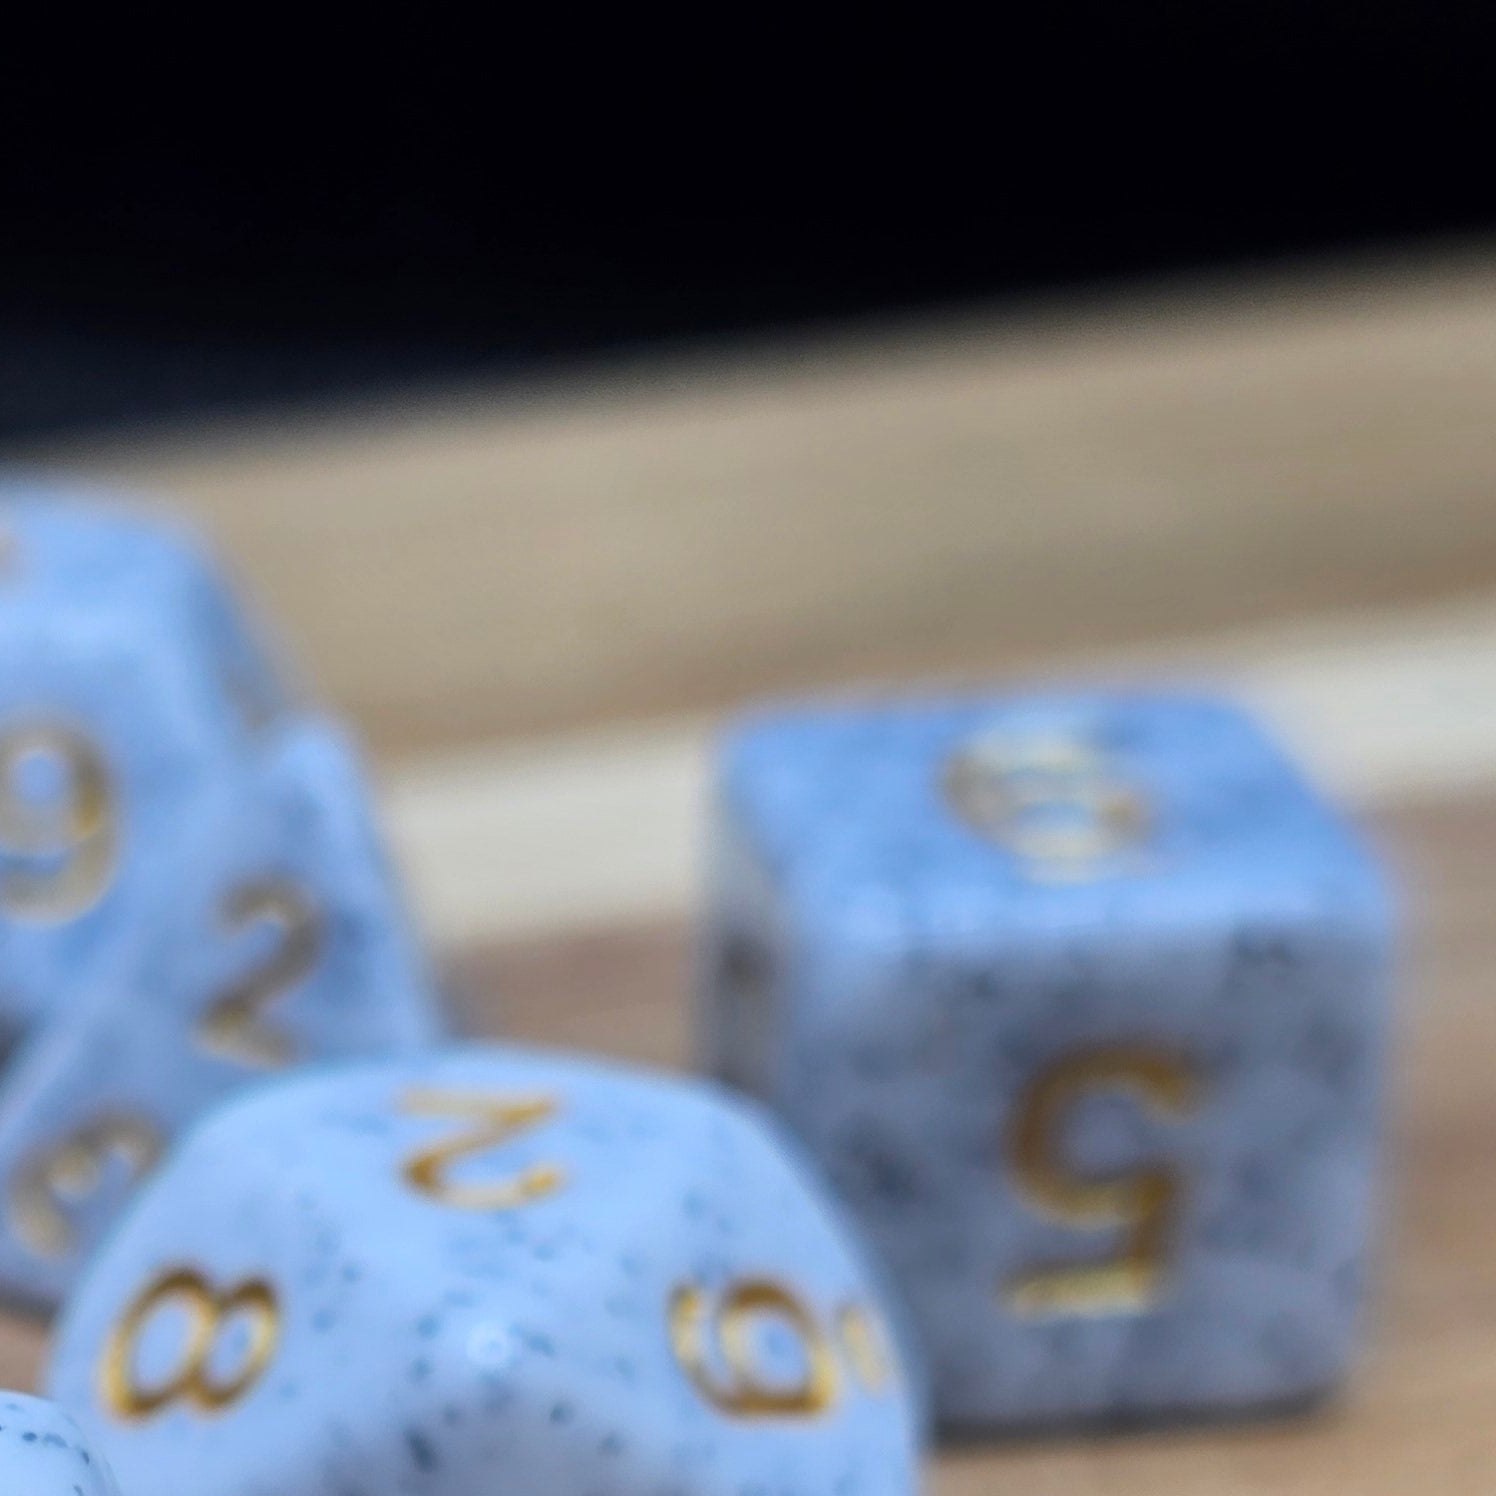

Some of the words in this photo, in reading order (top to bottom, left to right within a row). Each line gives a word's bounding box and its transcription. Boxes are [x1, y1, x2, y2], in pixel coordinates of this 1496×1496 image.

[394, 1085, 564, 1213] 2
[1001, 1040, 1201, 1325] 5
[100, 1262, 282, 1428] 8
